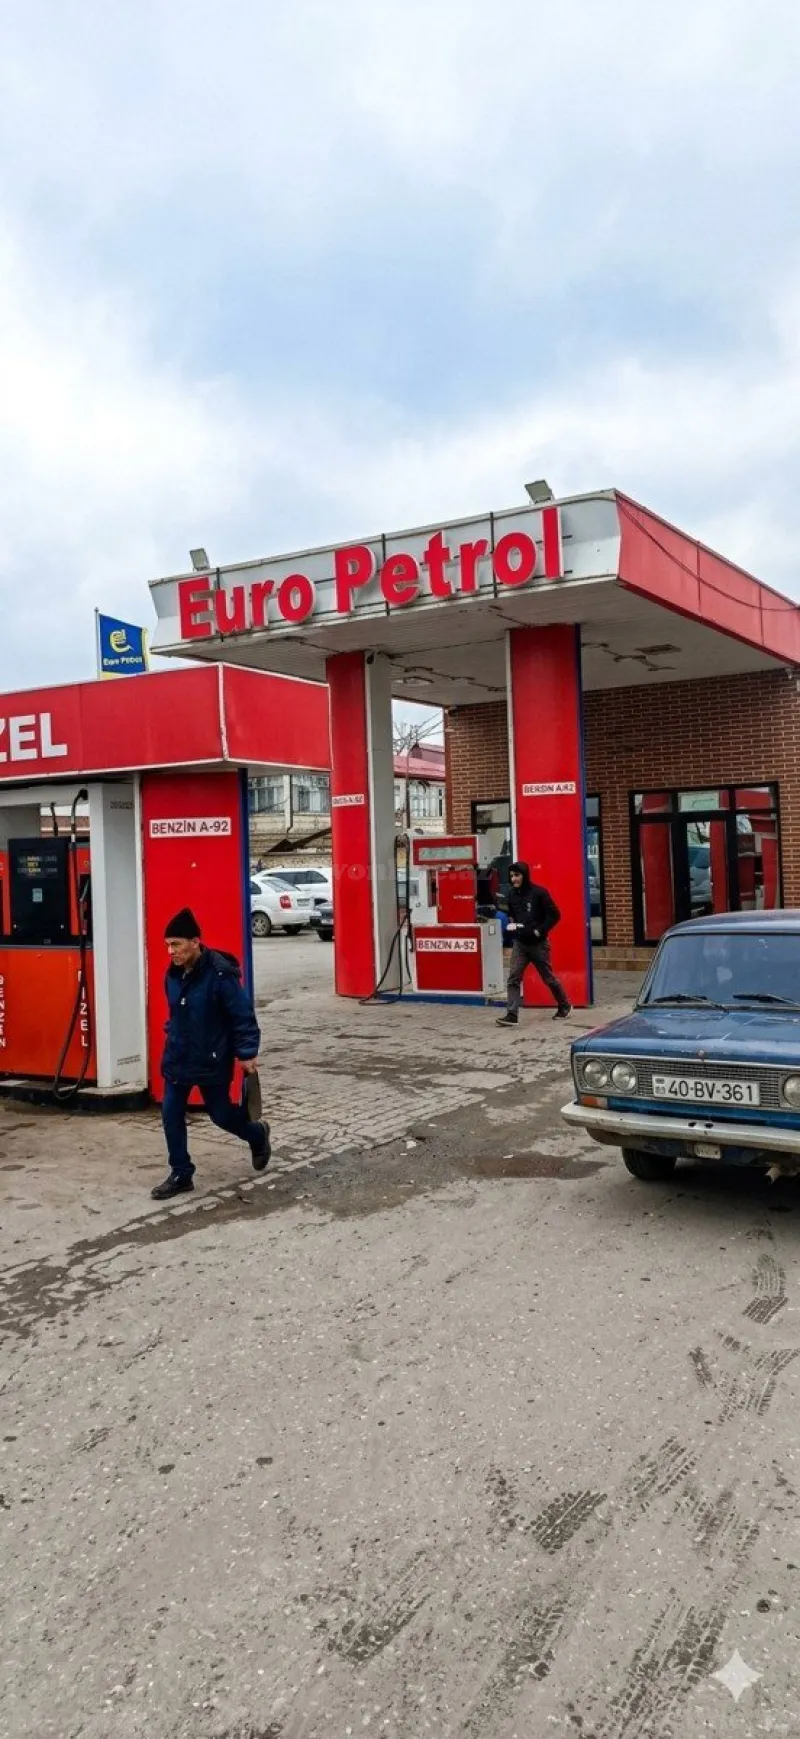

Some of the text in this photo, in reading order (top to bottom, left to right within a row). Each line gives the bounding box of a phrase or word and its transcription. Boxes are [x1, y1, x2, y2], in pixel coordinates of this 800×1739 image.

[178, 506, 562, 641] Euro Petrol
[200, 820, 229, 833] A-92
[668, 1080, 754, 1102] 40-BV-361
